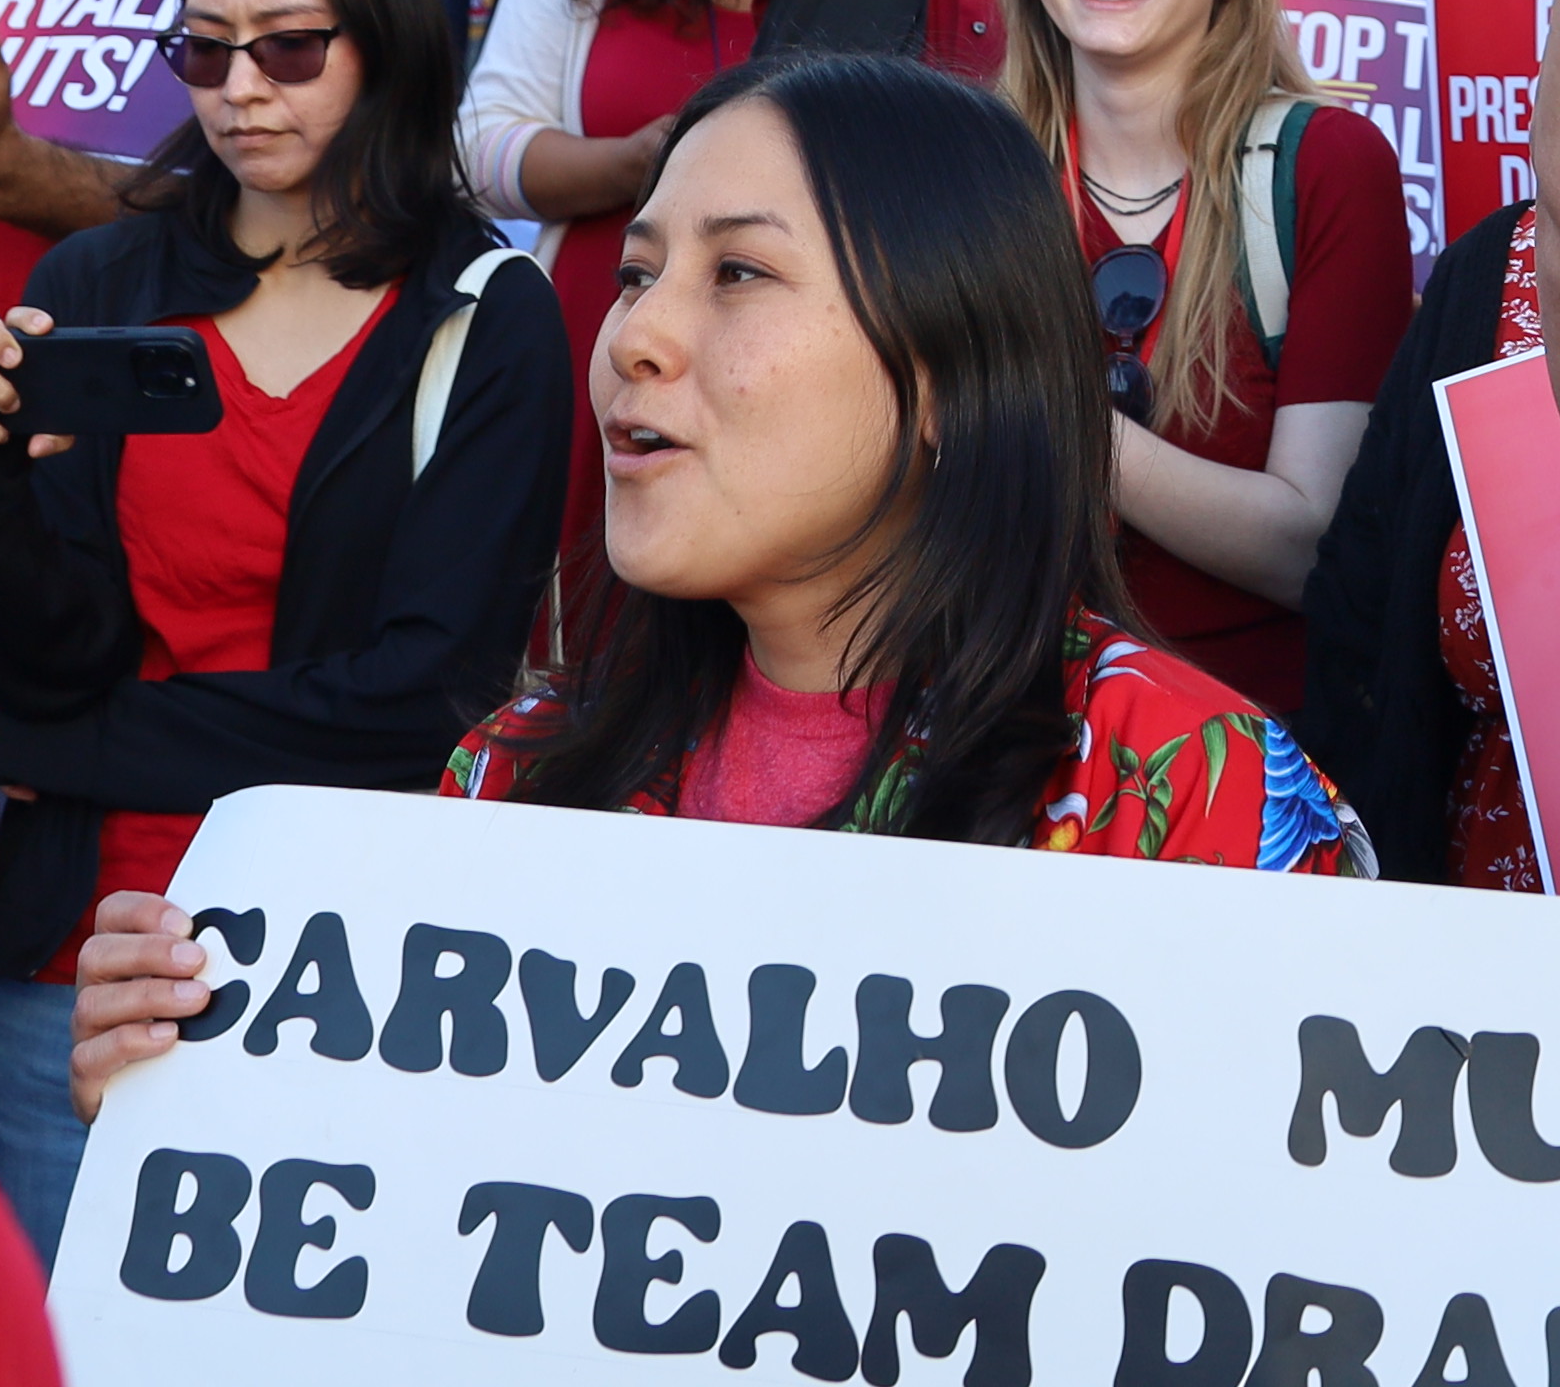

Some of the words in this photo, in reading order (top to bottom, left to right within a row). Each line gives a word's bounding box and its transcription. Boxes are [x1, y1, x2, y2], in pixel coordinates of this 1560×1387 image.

[177, 905, 1144, 1150] CARVALHO
[119, 1146, 376, 1319] BE
[458, 1178, 1046, 1387] TEAM
